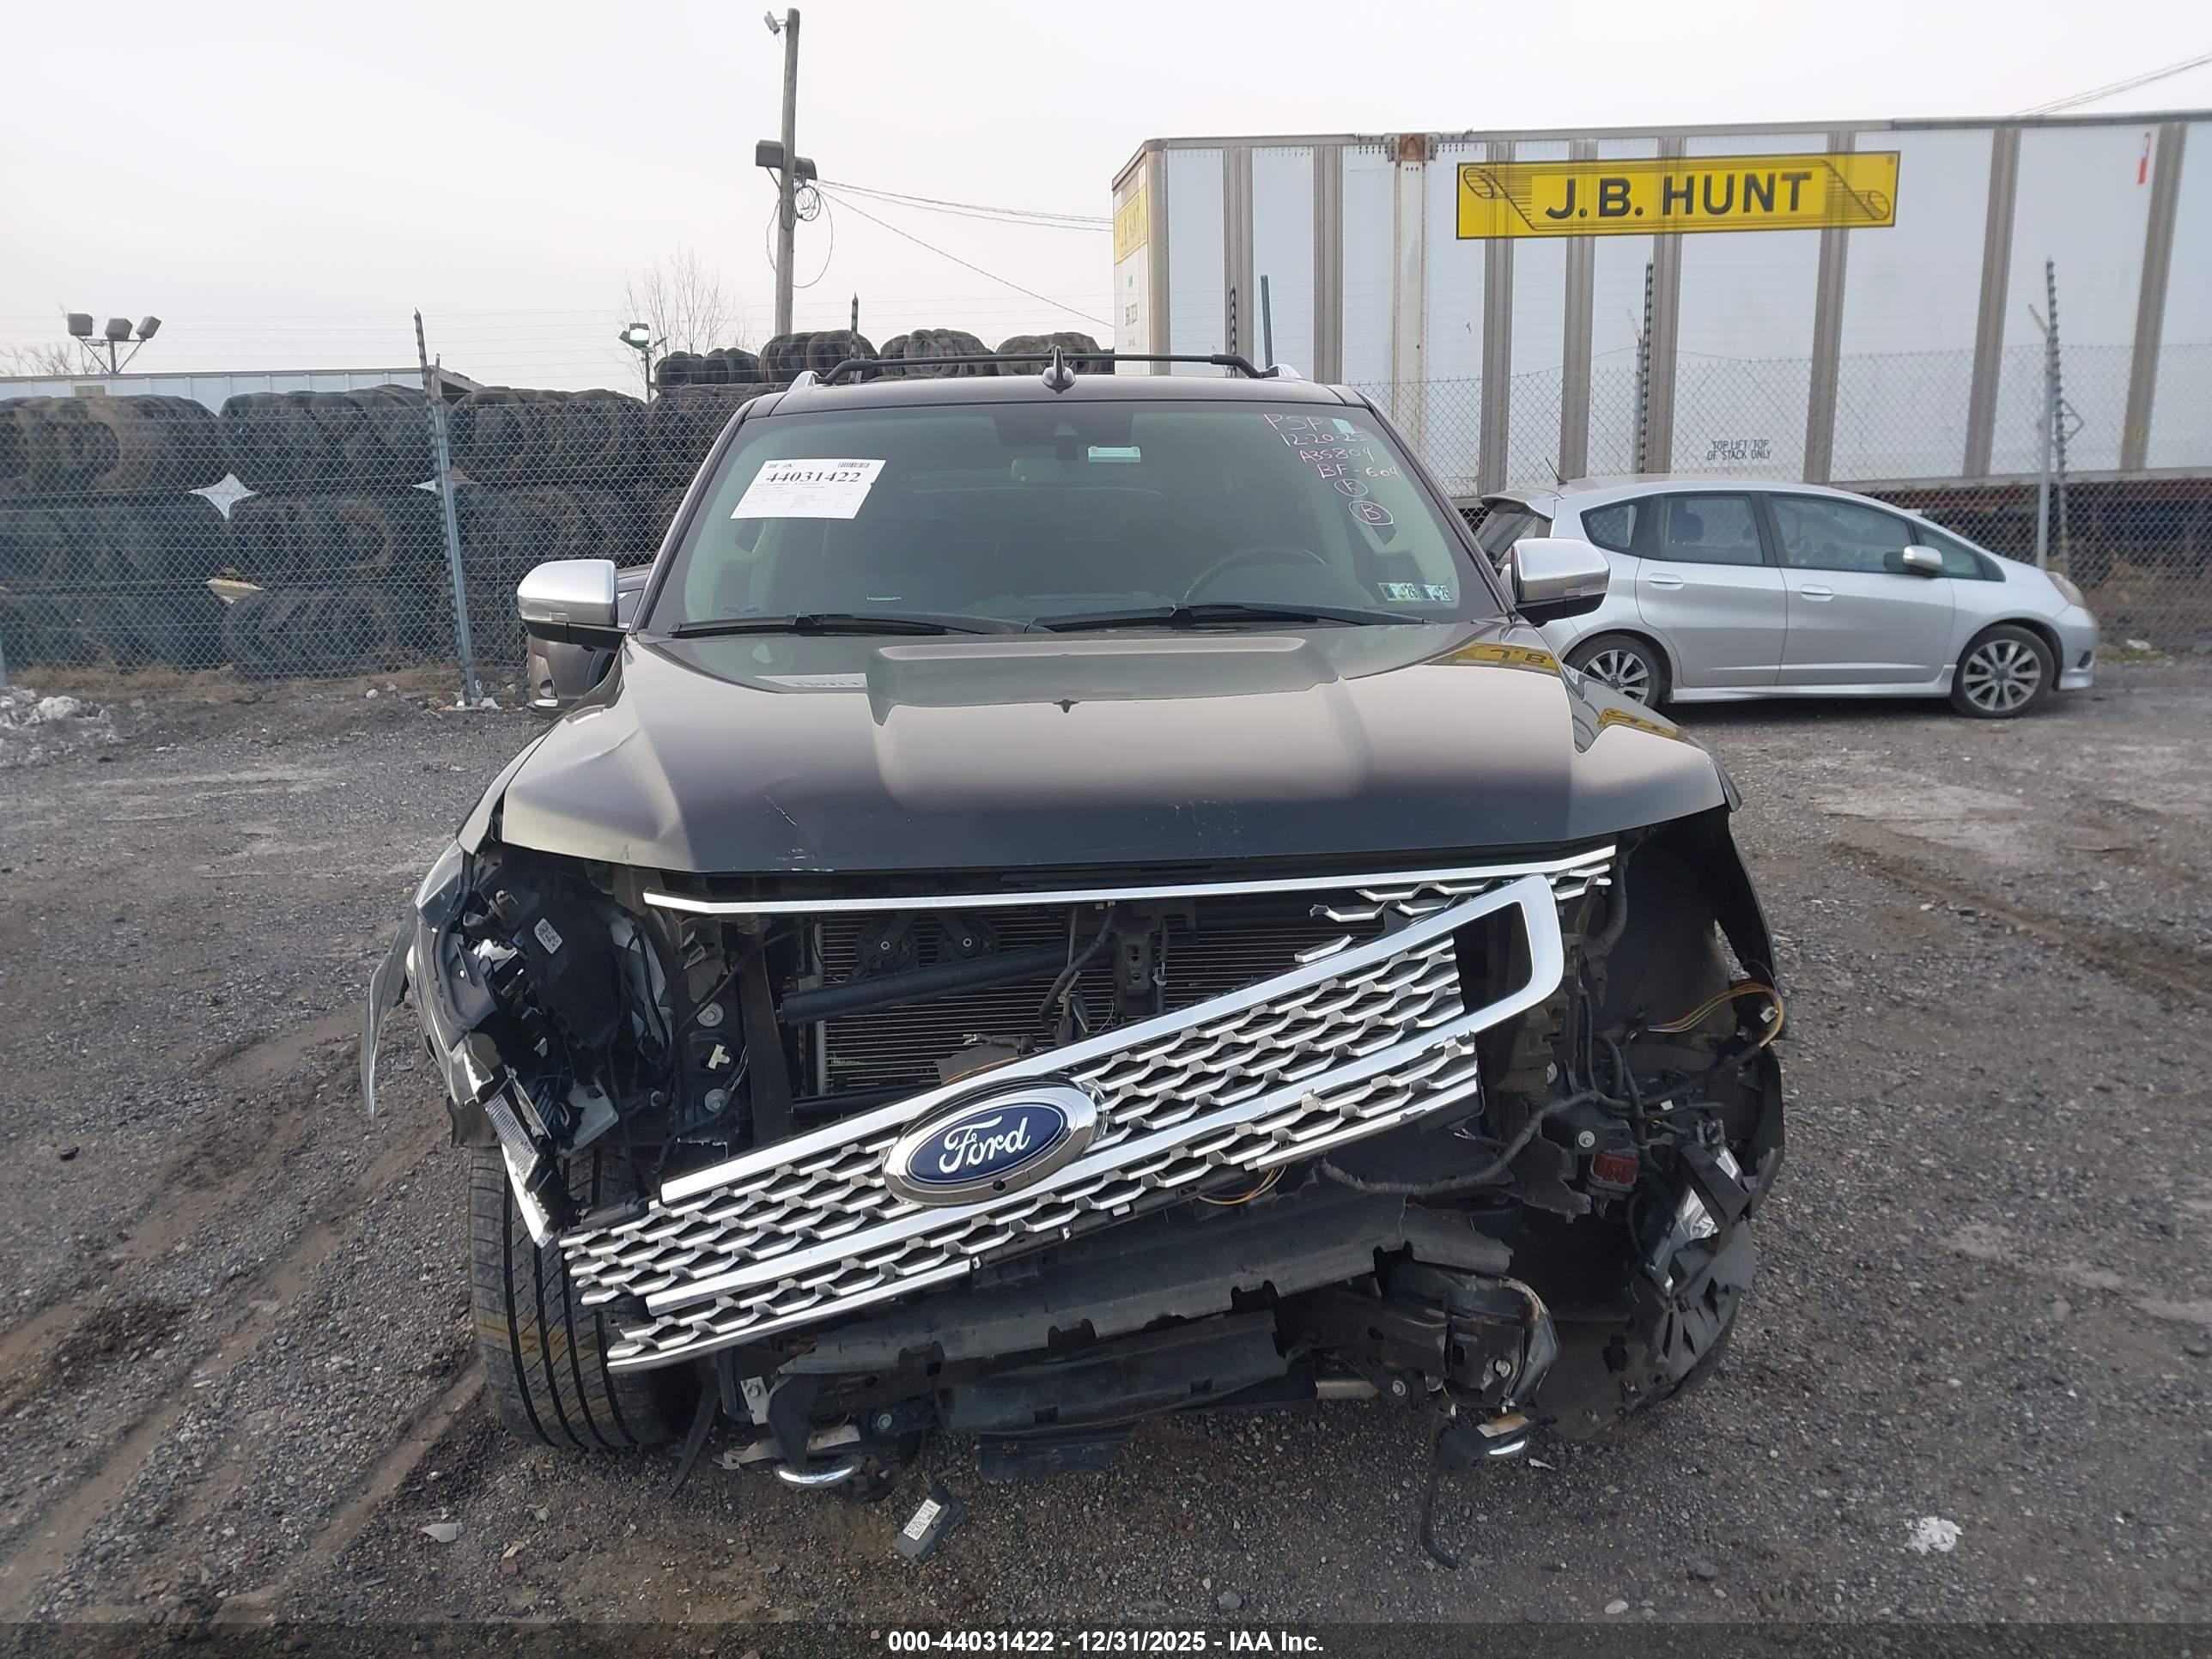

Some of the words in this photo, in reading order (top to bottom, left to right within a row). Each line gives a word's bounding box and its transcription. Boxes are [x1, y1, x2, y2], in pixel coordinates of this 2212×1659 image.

[1545, 177, 1644, 220] J.B.
[1662, 172, 1813, 216] HUNT
[1712, 441, 1729, 451] TOP
[1730, 440, 1748, 450] LIFT
[1753, 439, 1770, 450] TOP
[1707, 451, 1718, 461] OF
[1722, 449, 1747, 460] STACK
[1751, 449, 1771, 459] ONLY
[766, 471, 861, 483] 44031422
[939, 1115, 1031, 1174] Ford
